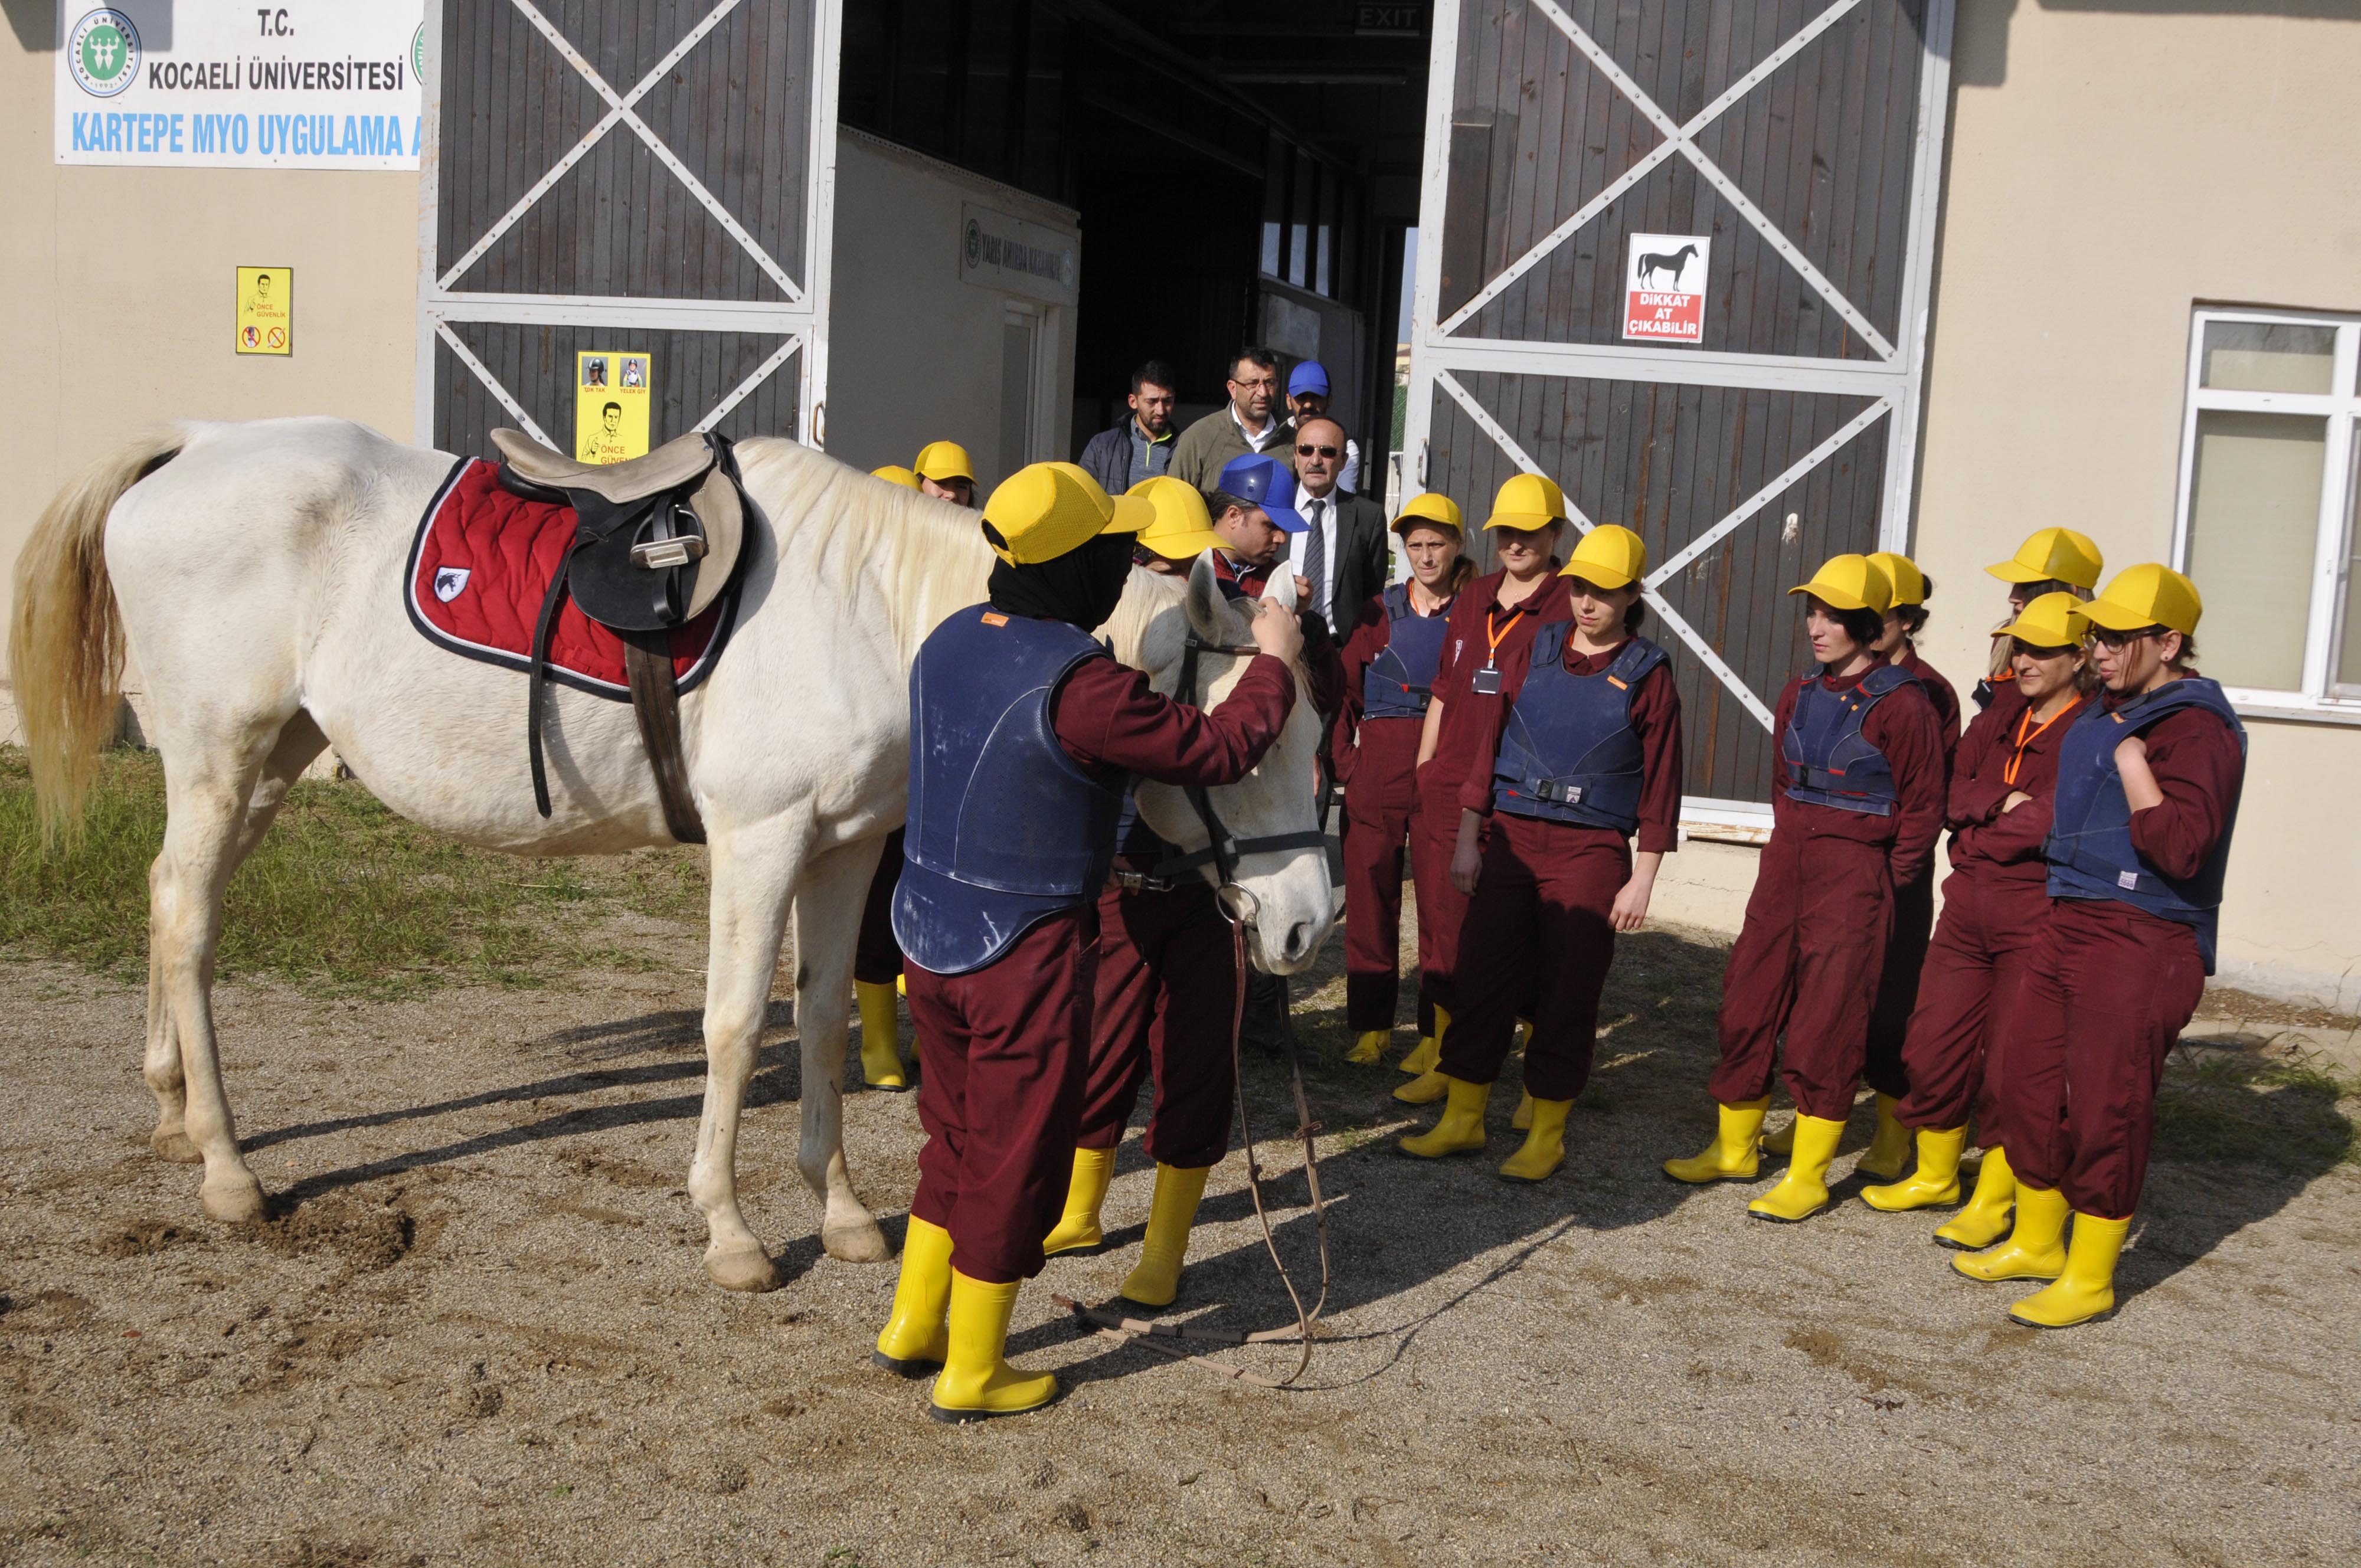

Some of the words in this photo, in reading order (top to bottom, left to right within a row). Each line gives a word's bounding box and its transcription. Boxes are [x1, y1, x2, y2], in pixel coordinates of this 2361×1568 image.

[258, 9, 295, 36] T.C.
[1360, 8, 1417, 27] EXIT
[149, 55, 240, 90] KOCAELİ
[249, 55, 403, 90] ÜNİVERSİTESİ
[73, 113, 184, 153] KARTEPE
[192, 113, 248, 155] MYO
[259, 113, 404, 156] UYGULAMA
[1654, 308, 1673, 319] AT
[601, 444, 625, 454] ÖNCE
